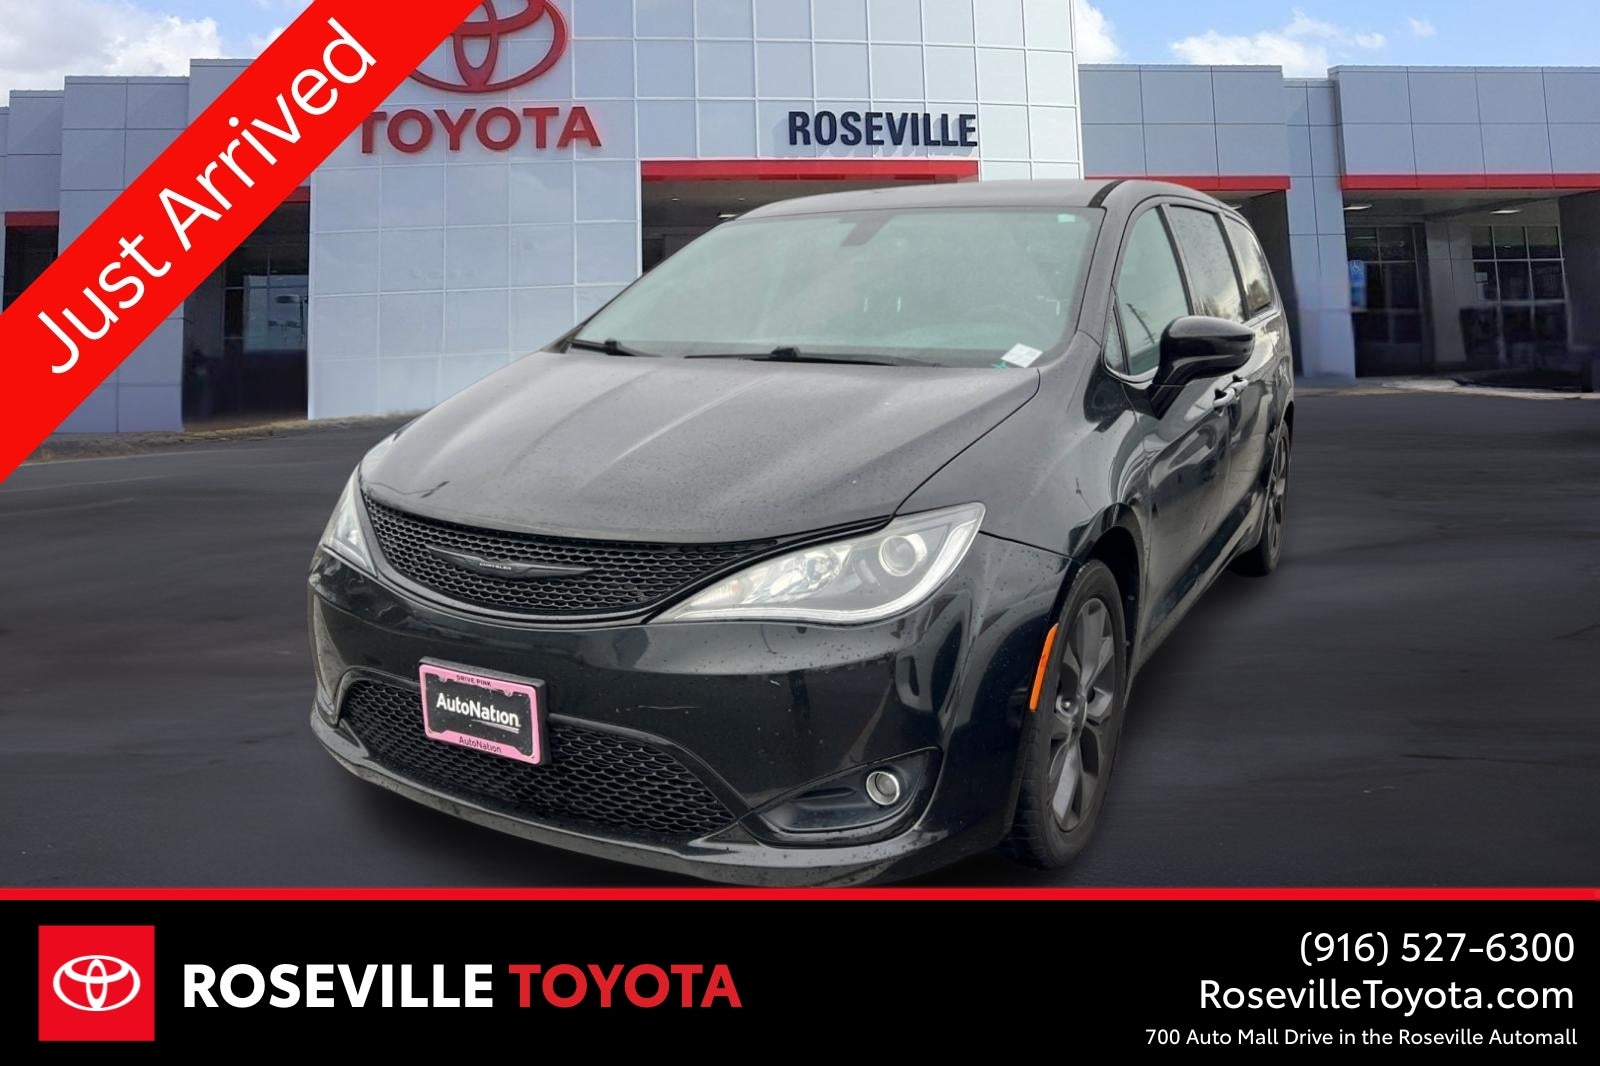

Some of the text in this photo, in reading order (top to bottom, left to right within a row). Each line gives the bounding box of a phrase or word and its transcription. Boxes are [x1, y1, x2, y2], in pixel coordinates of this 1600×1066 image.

[361, 106, 602, 154] TOYOTA
[788, 111, 978, 147] ROSEVILLE
[436, 693, 520, 727] AutoNation
[459, 736, 501, 753] AutoNation
